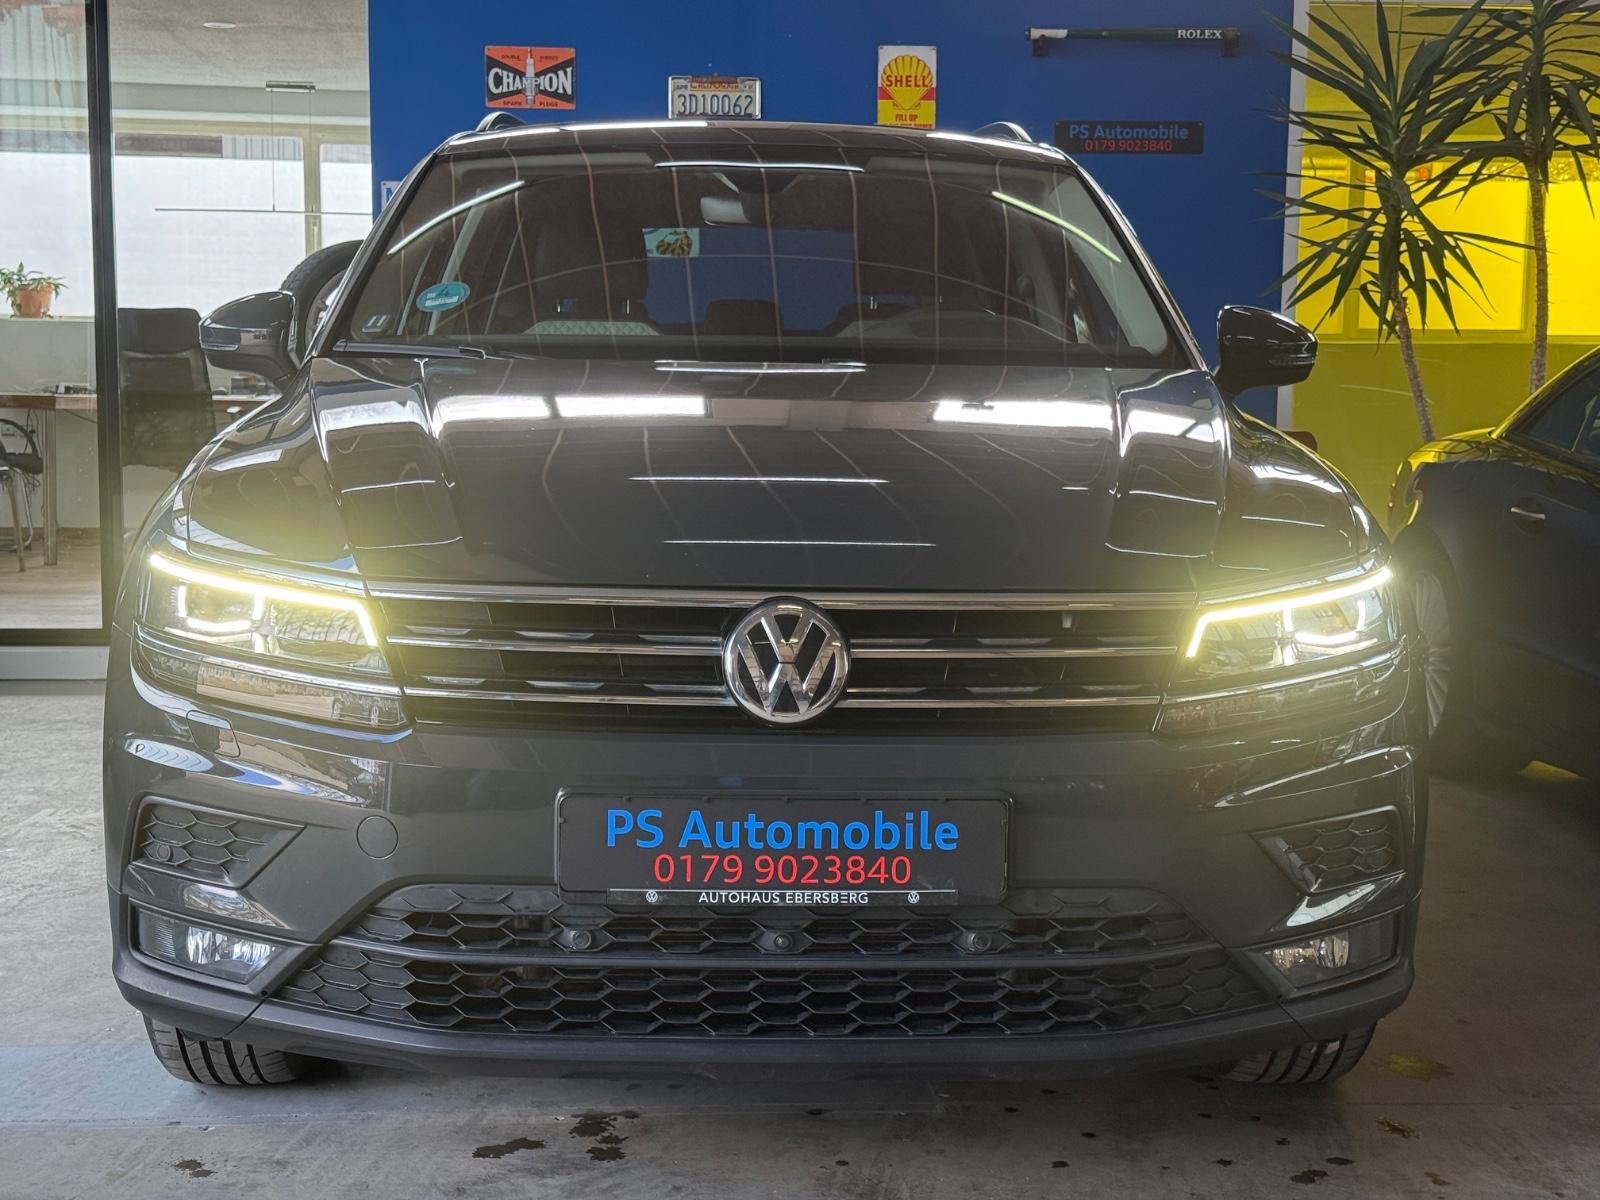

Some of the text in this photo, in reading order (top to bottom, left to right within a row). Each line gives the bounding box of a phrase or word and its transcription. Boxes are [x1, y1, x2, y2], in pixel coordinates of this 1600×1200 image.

[1177, 29, 1223, 40] ROLEX
[487, 66, 573, 96] CHAMPION
[885, 74, 929, 88] SHELL
[677, 93, 753, 116] 3D10062
[895, 113, 908, 122] FILL
[1069, 124, 1189, 140] PS Automobile
[1085, 139, 1173, 151] 0179 9023840
[607, 809, 960, 851] PS Automobile
[653, 853, 912, 885] 0179 9023840
[698, 892, 780, 904] AUTOHAUS
[785, 892, 869, 904] EBERSBERG
